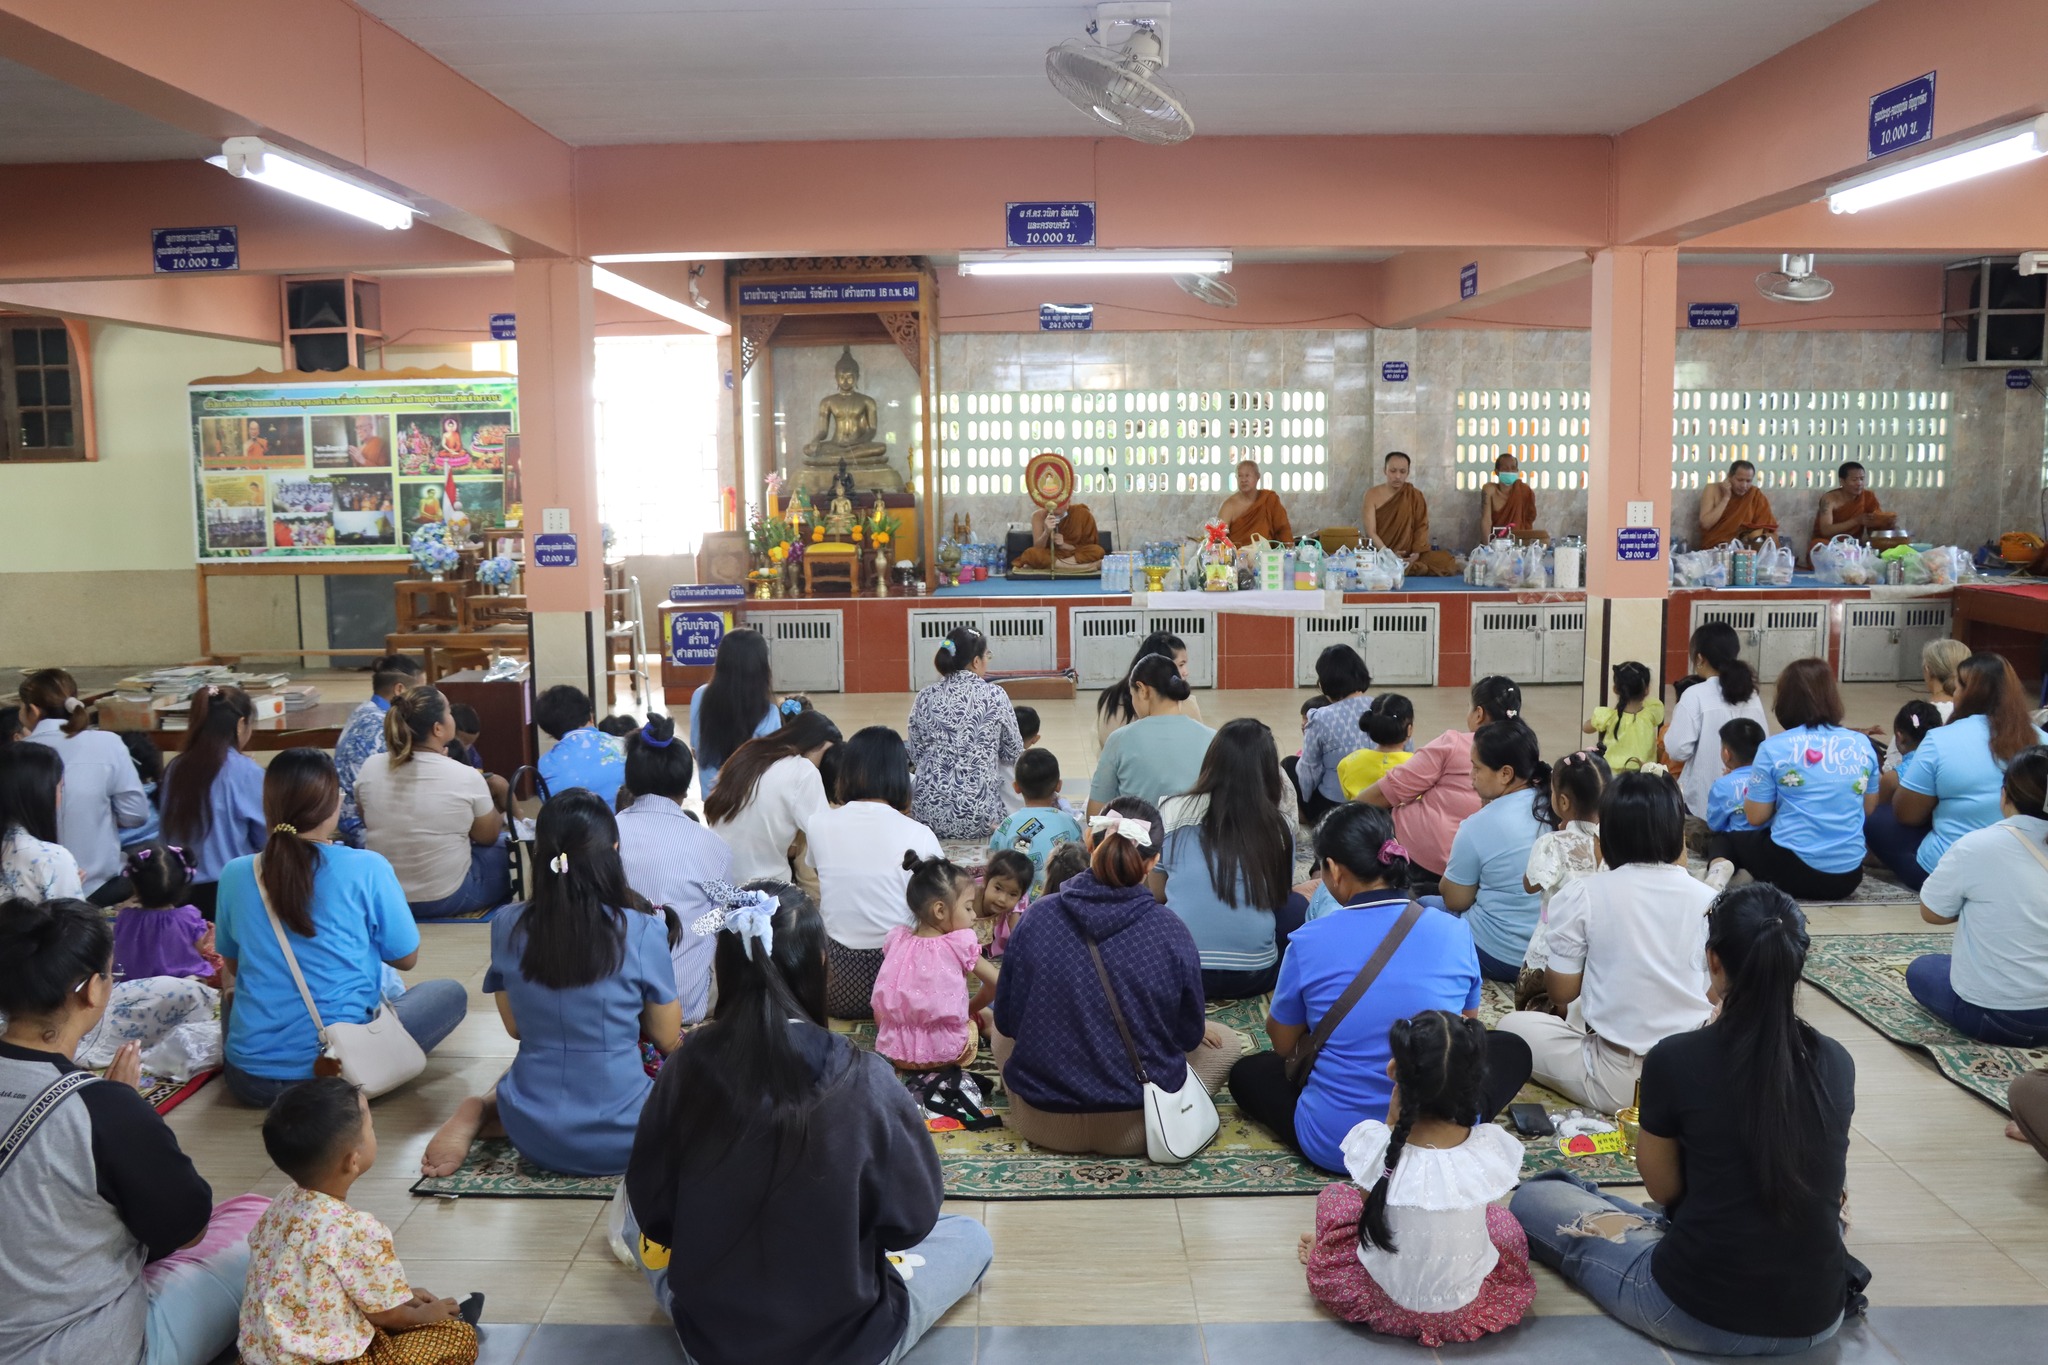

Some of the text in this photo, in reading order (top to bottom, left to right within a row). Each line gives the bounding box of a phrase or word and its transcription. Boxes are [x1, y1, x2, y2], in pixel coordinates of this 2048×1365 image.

[1027, 218, 1071, 230] และครอบครัว
[688, 631, 710, 645] สร้าง
[676, 643, 719, 658] ศาลาหอฉั
[1788, 733, 1820, 744] HAPPY
[1839, 765, 1861, 776] DAY
